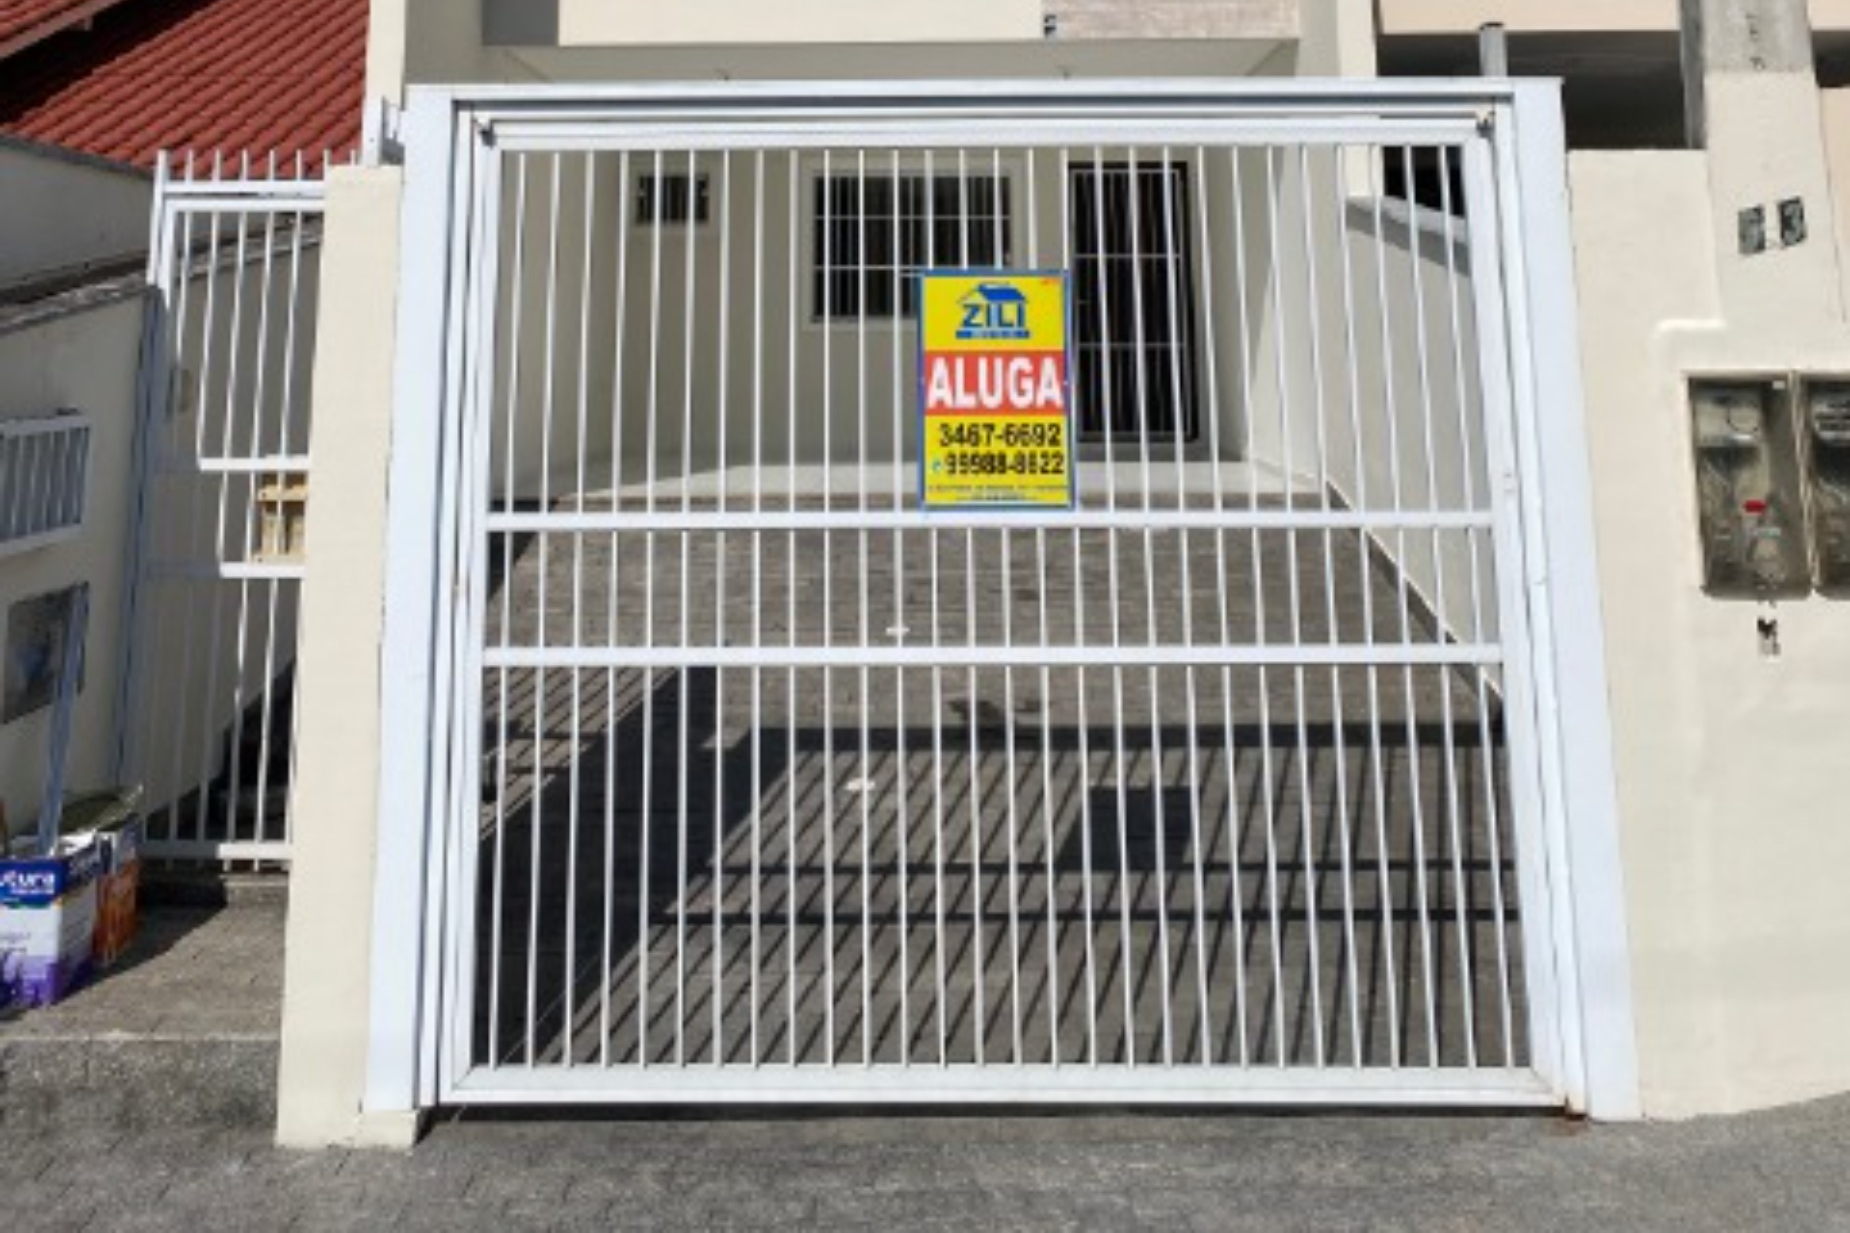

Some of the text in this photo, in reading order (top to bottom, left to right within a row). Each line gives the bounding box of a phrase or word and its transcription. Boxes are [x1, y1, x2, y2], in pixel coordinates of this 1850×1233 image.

[963, 303, 1025, 327] ZILI
[927, 357, 1063, 408] ALUGA
[939, 423, 1062, 447] 3467-6692
